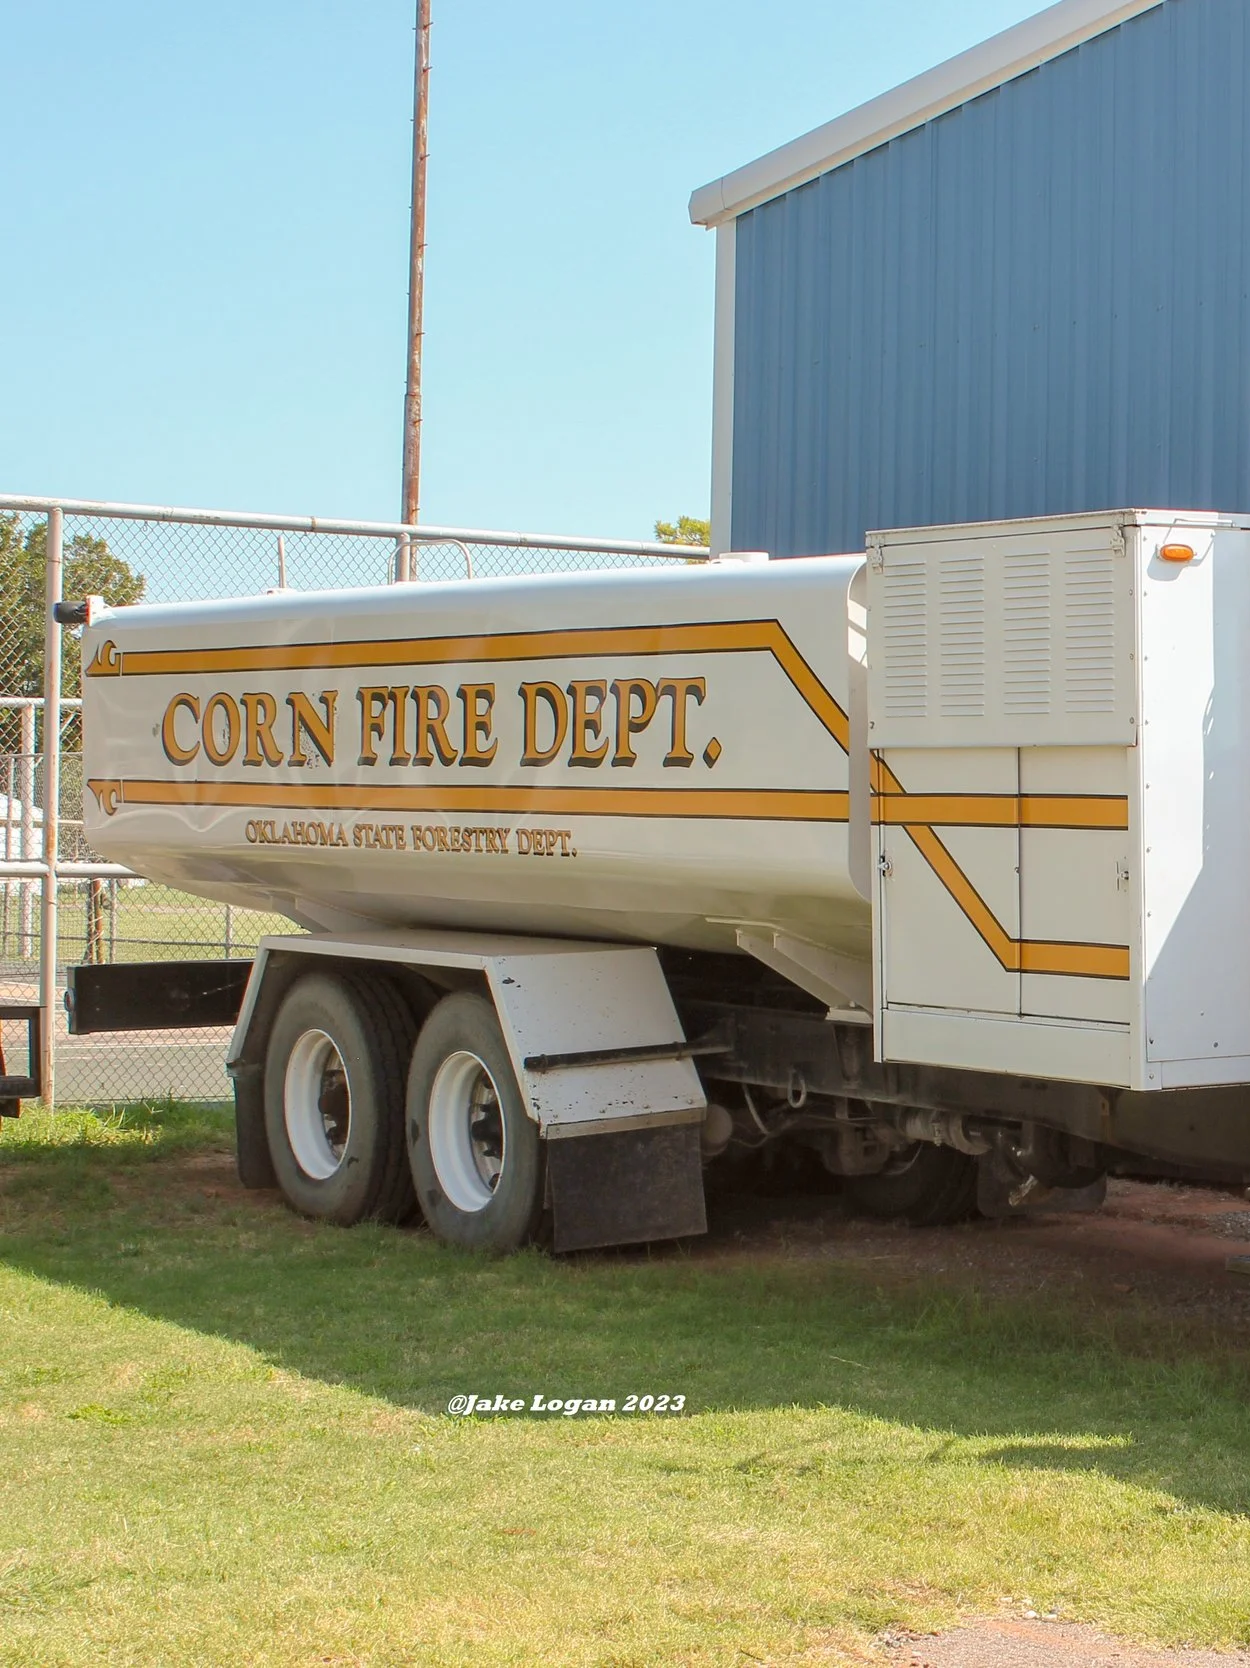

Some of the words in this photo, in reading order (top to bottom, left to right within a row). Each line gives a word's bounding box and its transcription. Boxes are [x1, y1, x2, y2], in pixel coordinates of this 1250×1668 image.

[161, 690, 339, 769] CORN
[355, 681, 501, 768] FIRE
[518, 676, 724, 769] DEPT.
[245, 821, 348, 847] OKLAHOMA
[352, 823, 407, 850] STATE
[411, 825, 511, 854] FORESTRY
[515, 828, 578, 857] DEPT.
